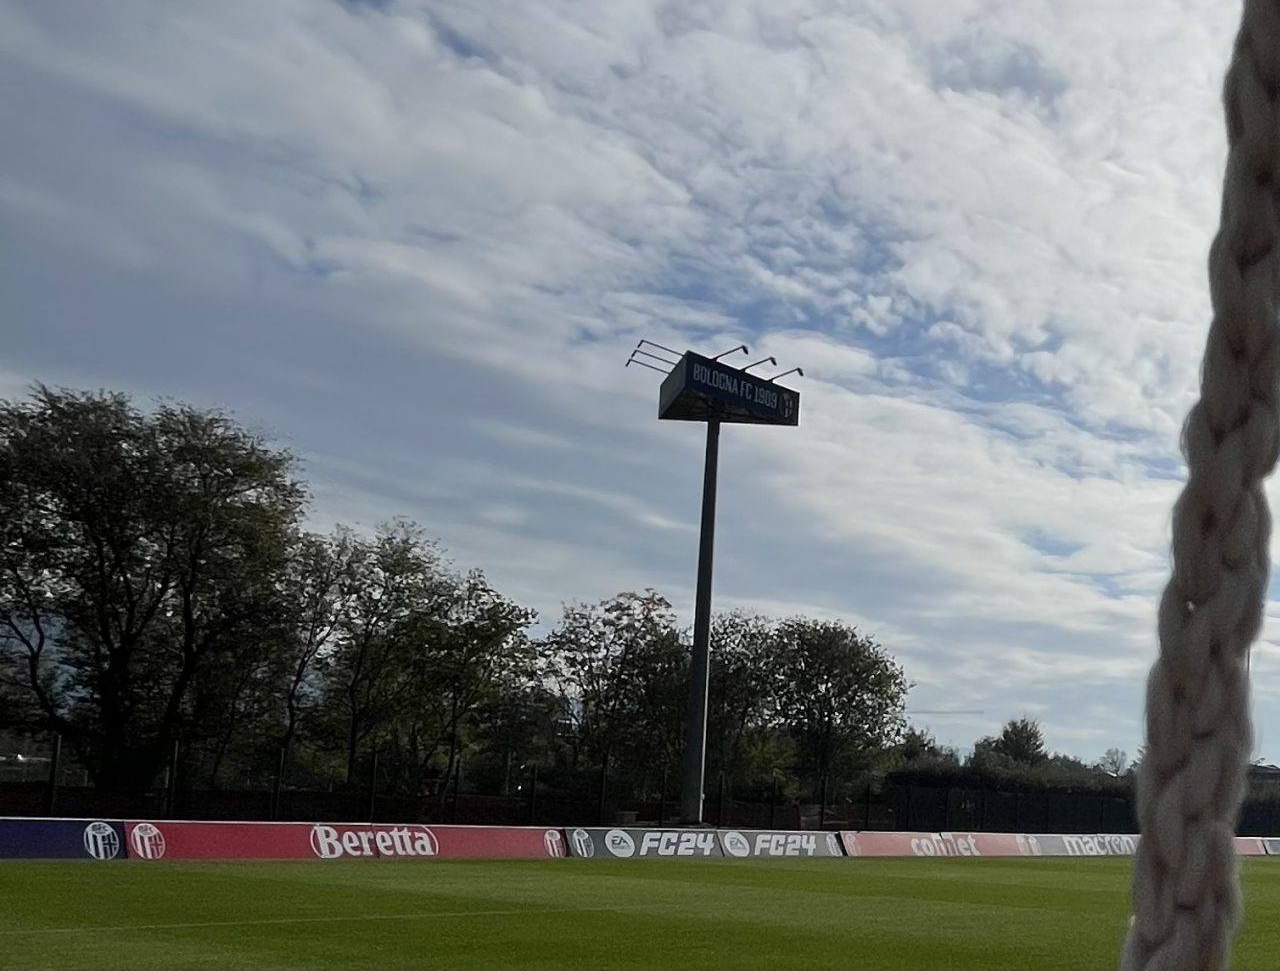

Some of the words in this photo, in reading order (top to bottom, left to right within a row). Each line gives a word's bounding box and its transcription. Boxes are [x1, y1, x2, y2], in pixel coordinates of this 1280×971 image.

[693, 363, 738, 396] BOLOGNA
[740, 380, 753, 400] FC
[754, 385, 779, 409] 1909
[313, 825, 435, 859] Beretta
[640, 832, 714, 856] FC24
[754, 834, 816, 856] FC24
[1062, 836, 1136, 855] macron
